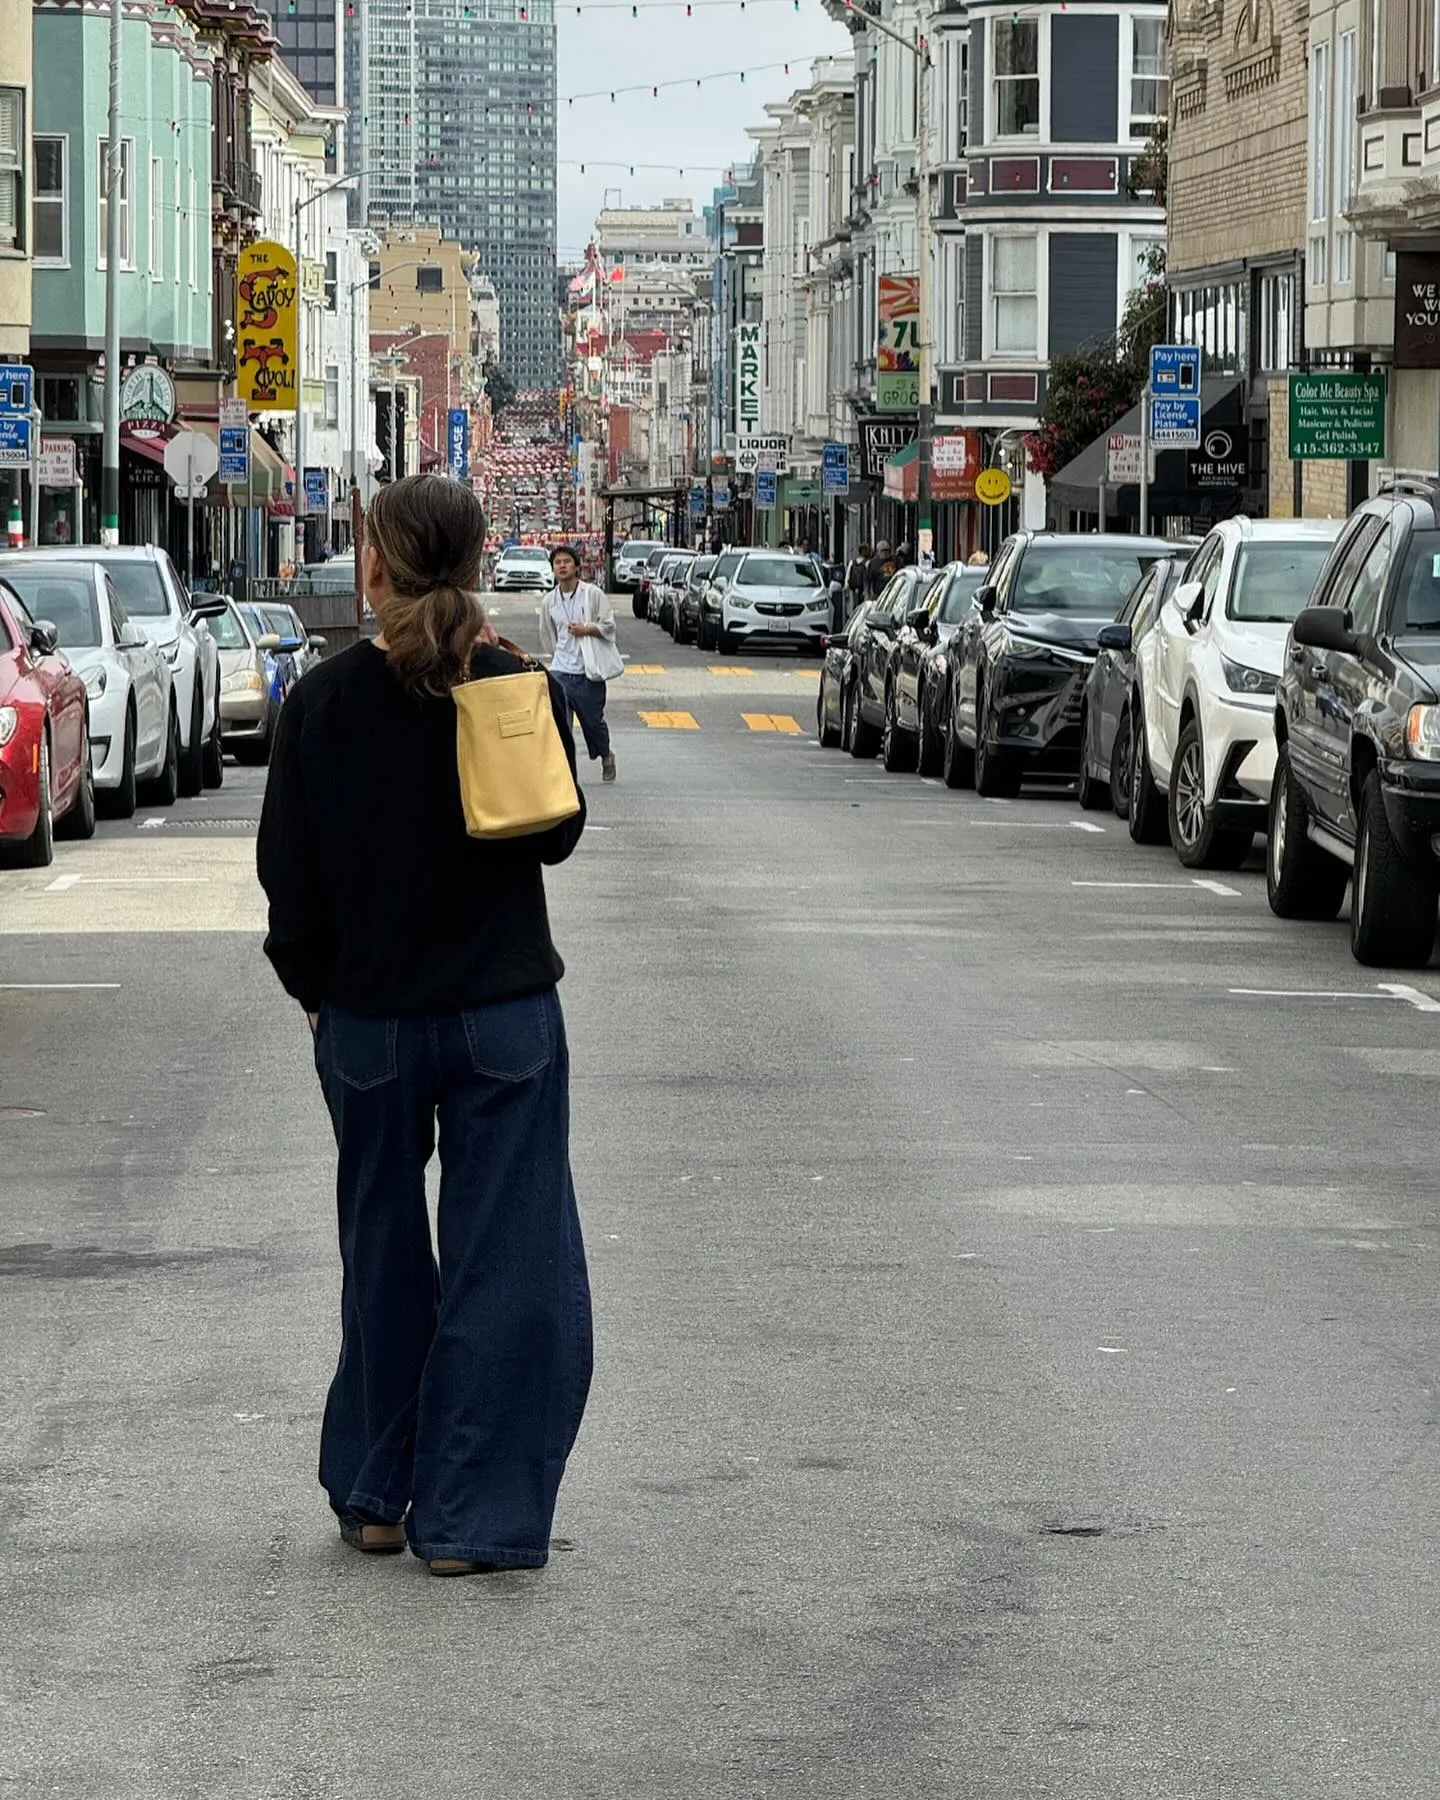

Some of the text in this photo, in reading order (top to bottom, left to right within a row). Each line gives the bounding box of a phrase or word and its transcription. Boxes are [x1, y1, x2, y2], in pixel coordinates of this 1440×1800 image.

[250, 254, 269, 263] THE
[1412, 284, 1436, 298] WE
[1154, 351, 1198, 363] Pay here
[6, 369, 29, 380] here
[740, 326, 759, 433] MARKET
[1295, 382, 1318, 399] Color
[1334, 383, 1361, 402] Beauty
[1363, 382, 1380, 403] Spa
[1154, 400, 1186, 412] Pay by
[1154, 410, 1188, 420] License
[3, 421, 16, 432] by
[127, 421, 166, 433] PIZZA
[1154, 419, 1178, 428] Plate
[453, 425, 464, 468] CHASE
[740, 439, 787, 449] LIQUOR
[1109, 434, 1124, 449] NO
[44, 443, 72, 453] PARKING
[1190, 463, 1245, 475] THE HIVE
